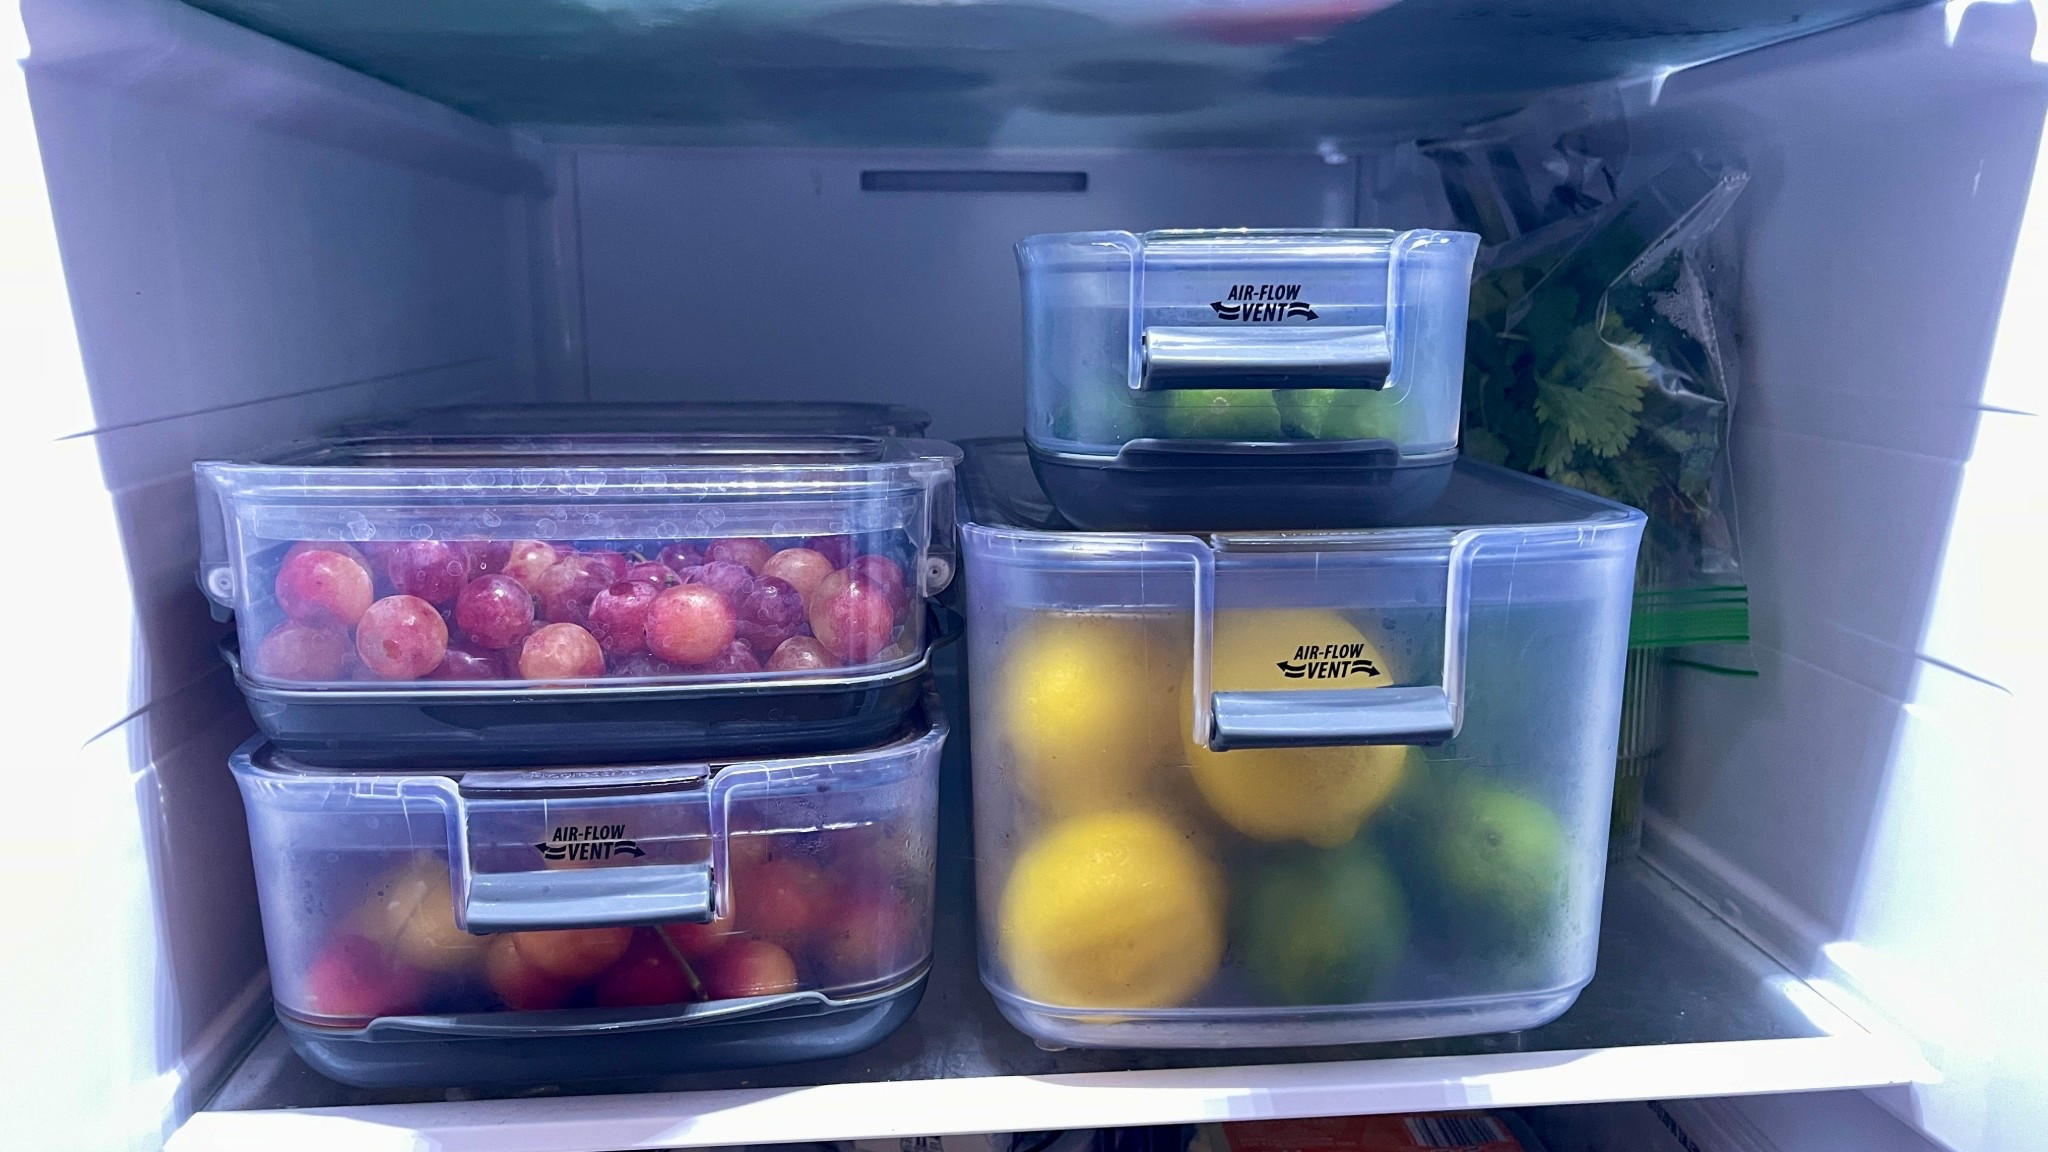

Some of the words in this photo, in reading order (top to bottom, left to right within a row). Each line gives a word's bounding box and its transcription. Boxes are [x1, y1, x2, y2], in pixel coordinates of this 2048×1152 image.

[1227, 284, 1302, 301] AIR-FLOW
[1242, 302, 1288, 322] VENT
[1293, 643, 1365, 661] AIR-FLOW
[1307, 660, 1352, 679] VENT
[552, 824, 626, 842] AIR-FLOW
[567, 841, 614, 861] VENT
